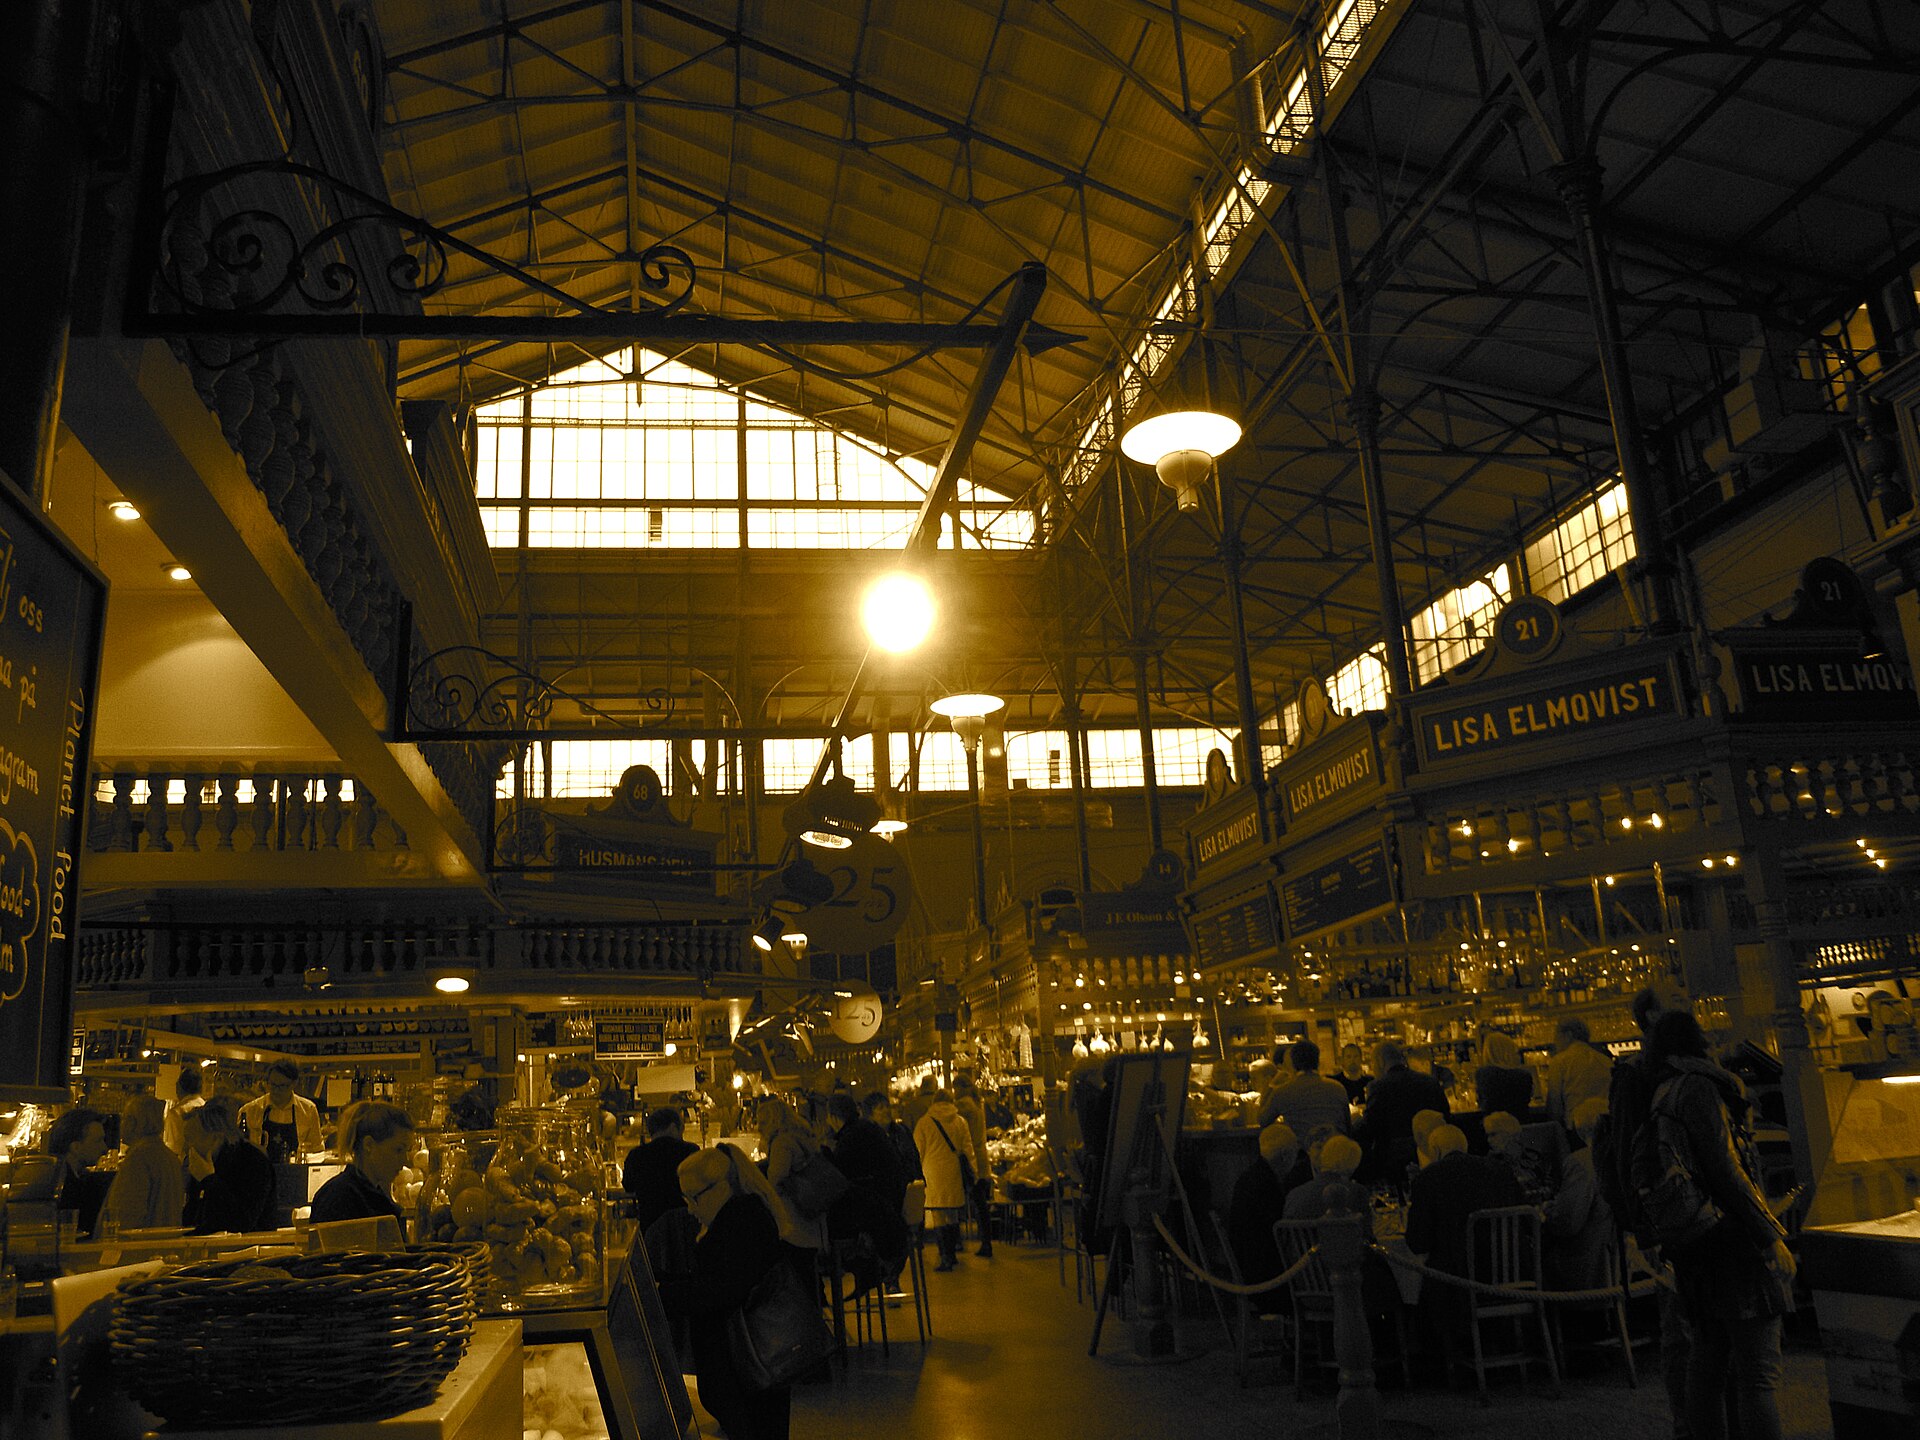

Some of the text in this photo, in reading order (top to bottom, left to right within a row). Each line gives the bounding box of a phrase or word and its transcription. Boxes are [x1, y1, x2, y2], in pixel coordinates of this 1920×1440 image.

[1820, 580, 1842, 601] 21
[19, 594, 43, 633] oss
[1515, 616, 1540, 641] 21
[18, 665, 37, 724] på
[1752, 663, 1913, 693] LISA ELMQV
[1433, 677, 1658, 752] LISA ELMQVIST
[633, 784, 649, 801] 68
[1290, 748, 1370, 814] LISA ELMQVIST
[1199, 812, 1257, 862] LISA ELMQVIST
